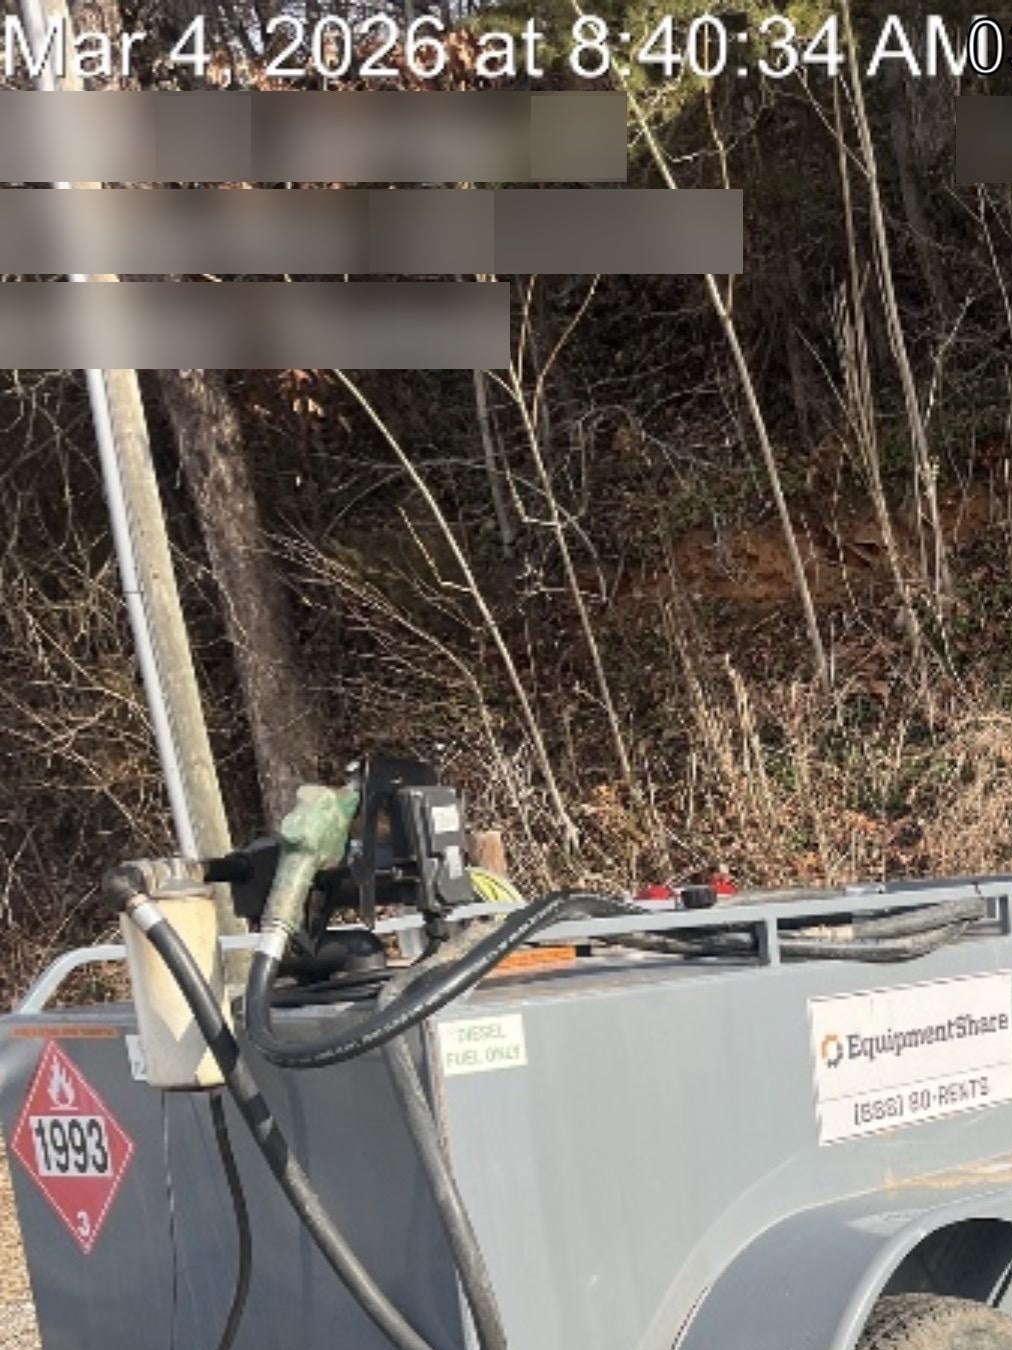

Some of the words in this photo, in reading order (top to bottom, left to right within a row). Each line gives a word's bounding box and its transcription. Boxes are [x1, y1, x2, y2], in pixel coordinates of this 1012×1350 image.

[446, 1049, 483, 1068] FUEL
[486, 1044, 520, 1063] ONLY
[846, 1013, 1009, 1062] EquipmentShare
[35, 1118, 108, 1174] 1993
[76, 1210, 91, 1237] 3
